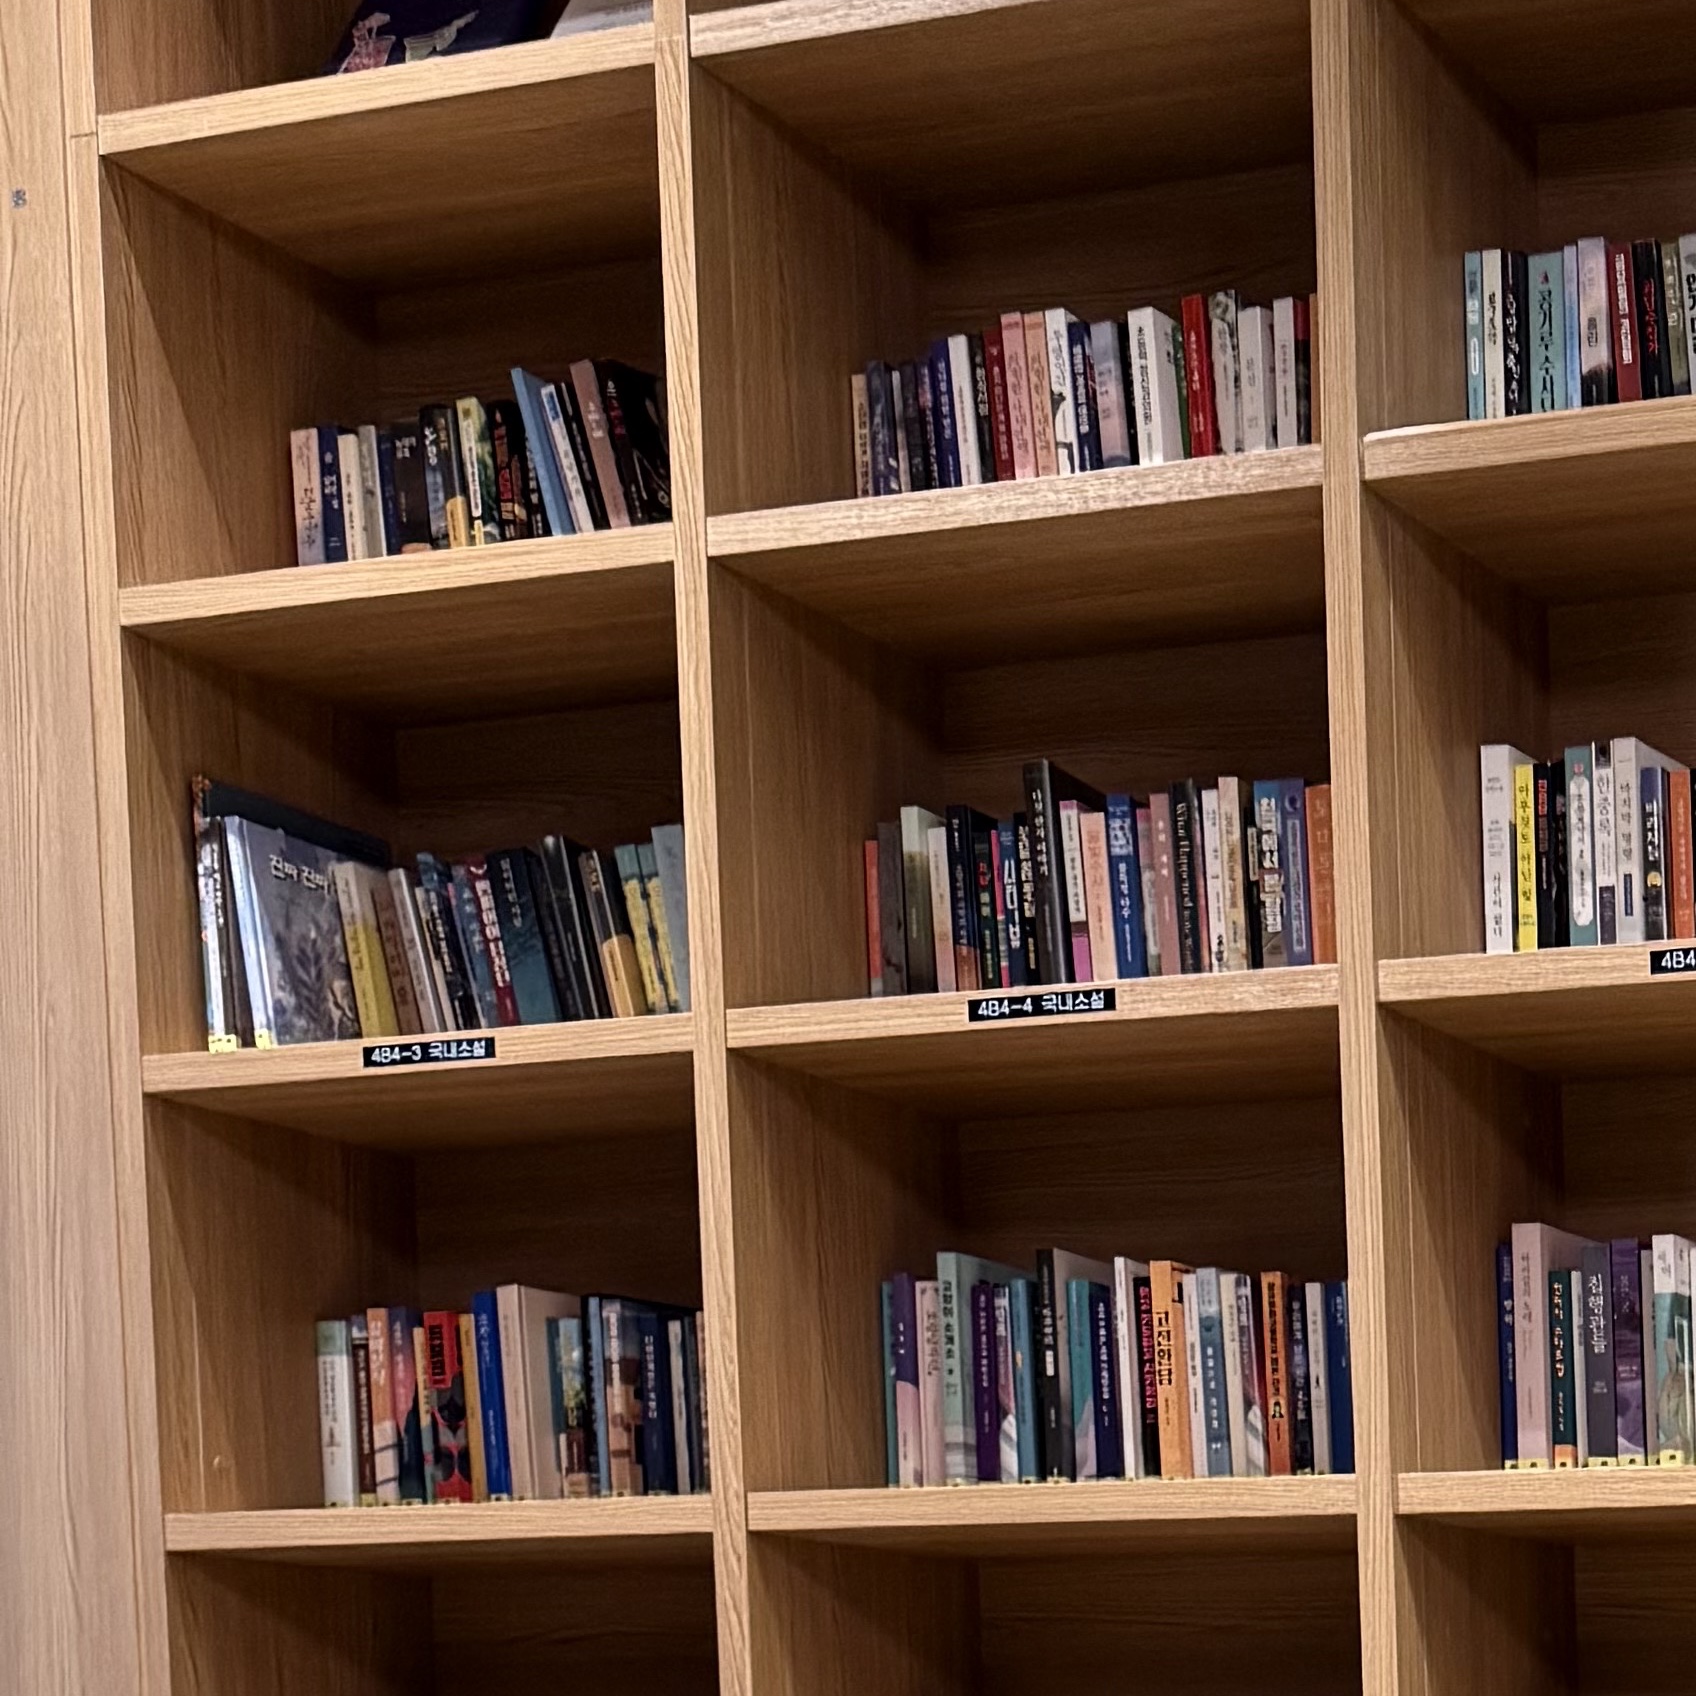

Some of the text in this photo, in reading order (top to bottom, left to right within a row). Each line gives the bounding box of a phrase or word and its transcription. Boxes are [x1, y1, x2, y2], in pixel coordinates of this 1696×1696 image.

[977, 990, 1105, 1016] 4B4-4 국내소설
[428, 1040, 486, 1059] 국내소설
